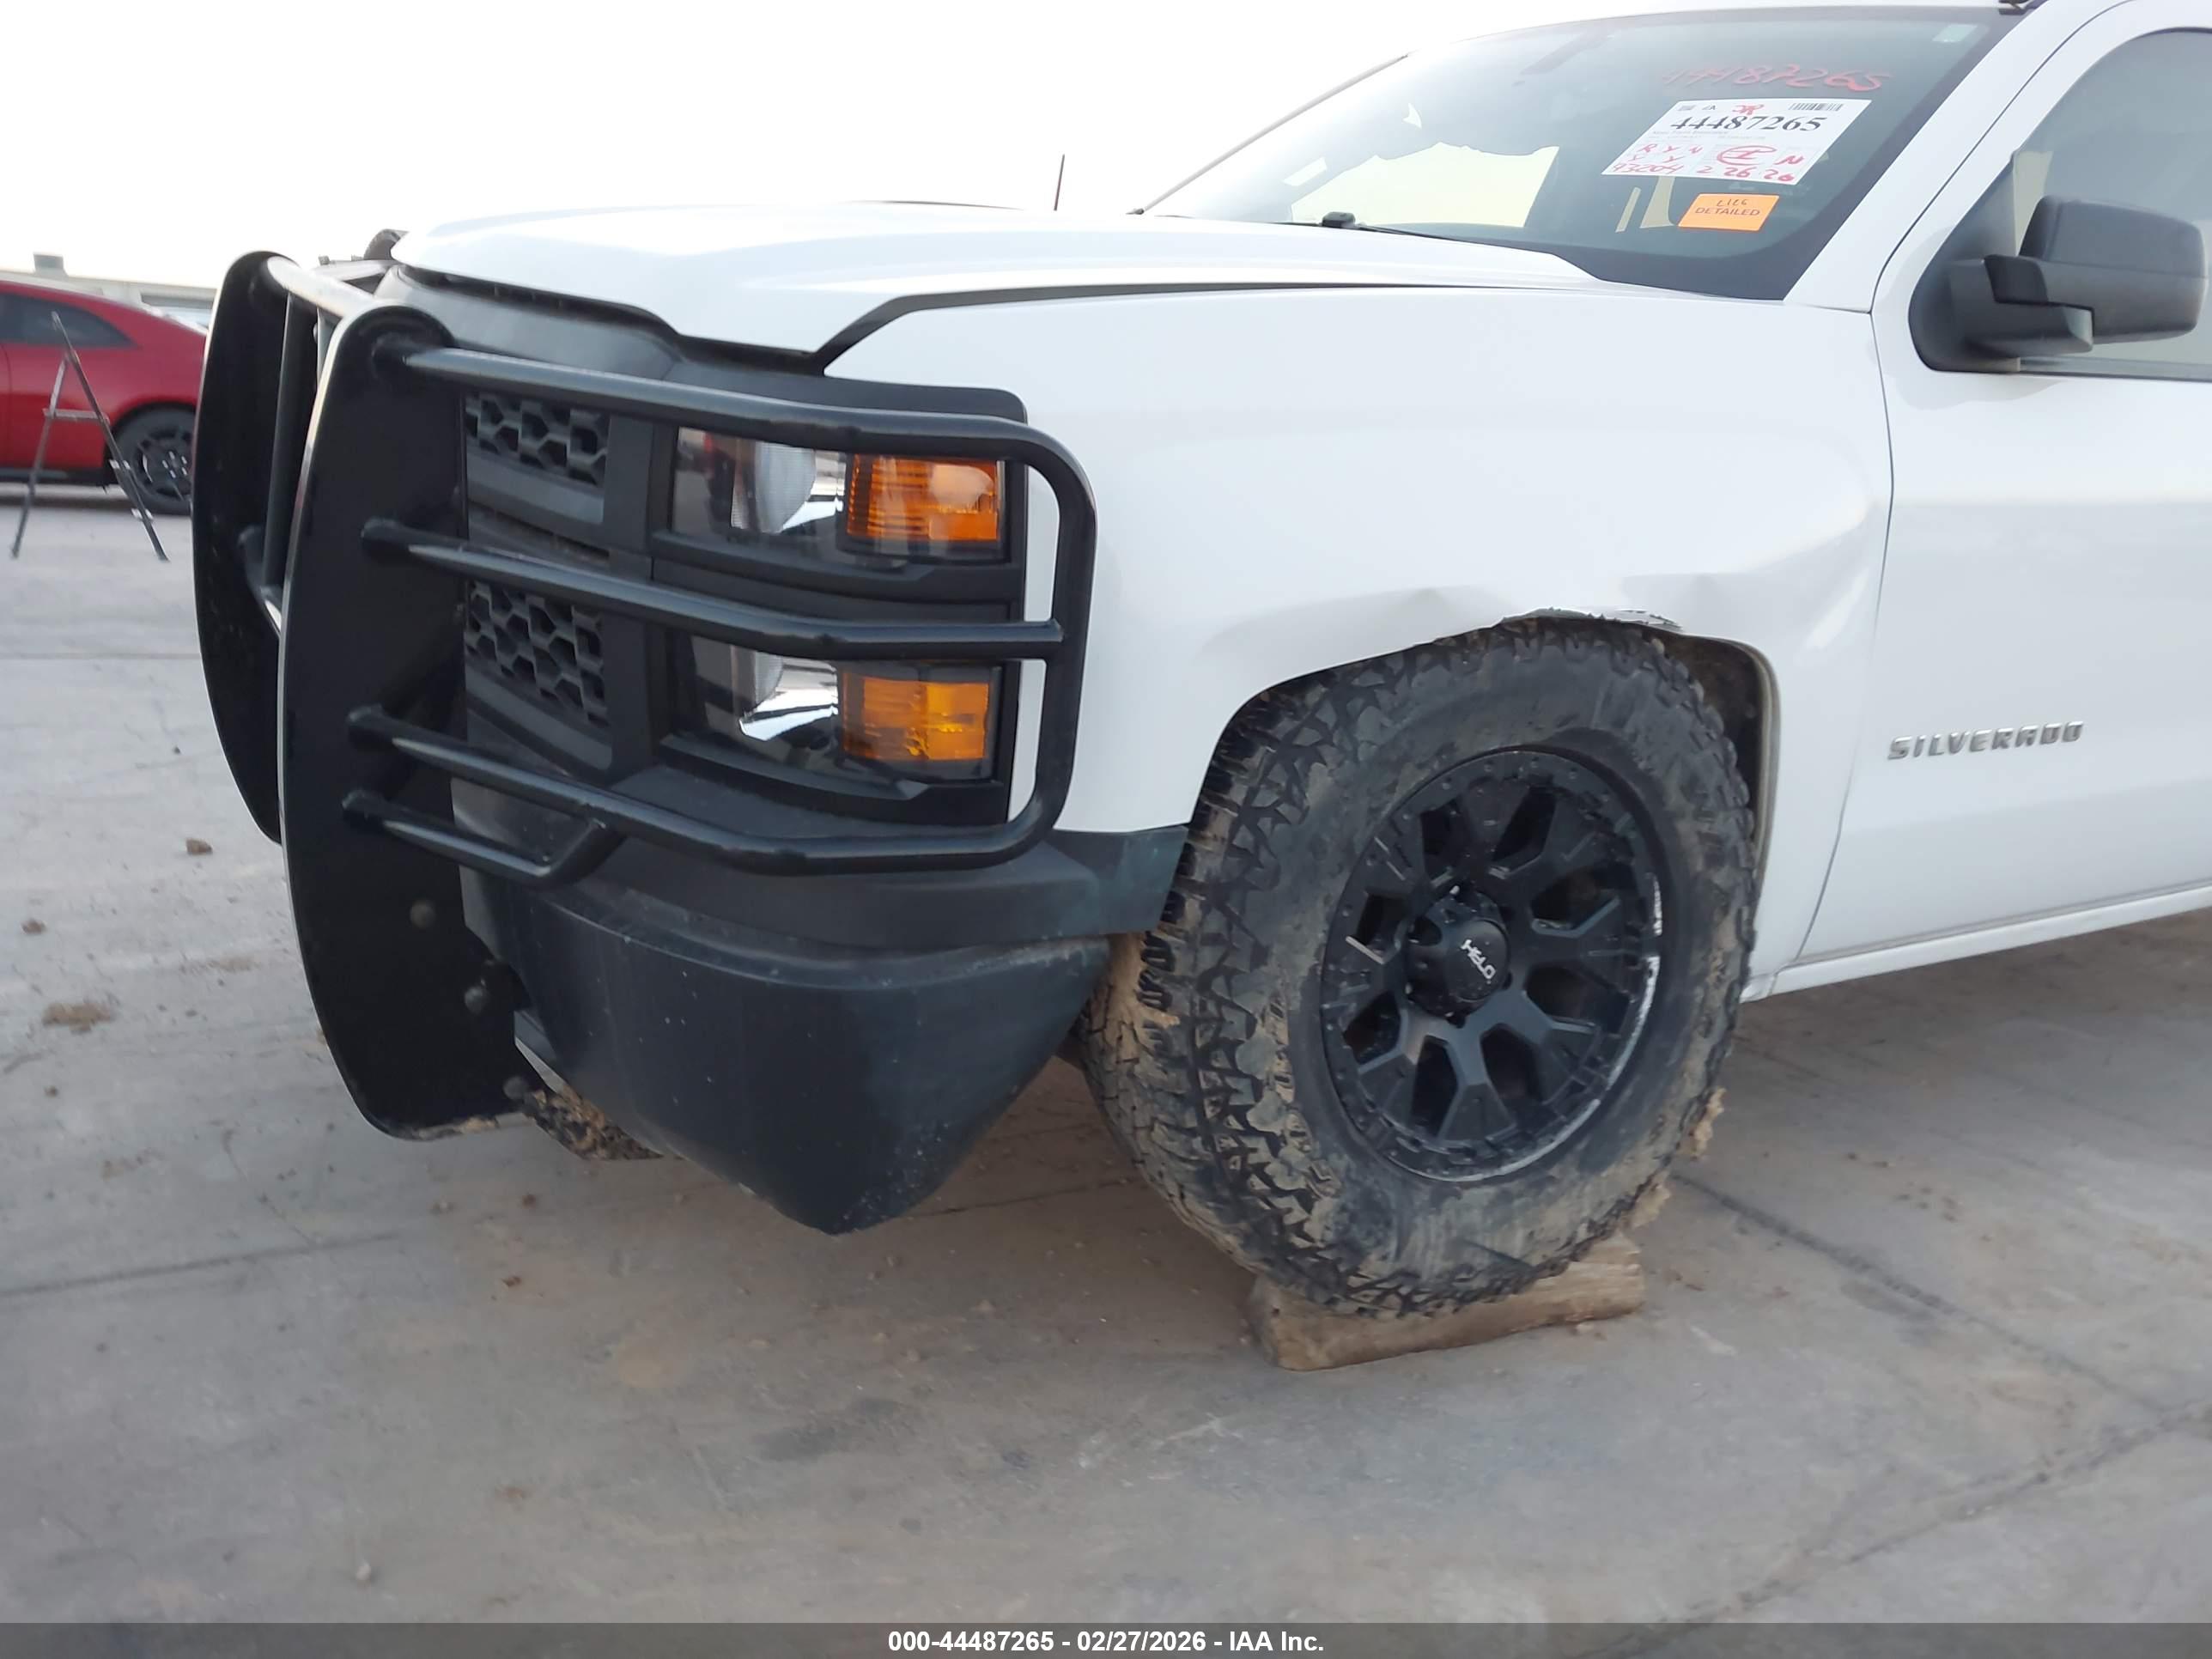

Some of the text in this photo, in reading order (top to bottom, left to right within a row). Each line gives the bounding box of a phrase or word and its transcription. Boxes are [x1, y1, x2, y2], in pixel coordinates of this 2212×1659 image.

[1670, 116, 1827, 131] 44487265
[1724, 167, 1757, 178] 26
[1695, 207, 1760, 216] DETAILED
[1887, 721, 2084, 760] SILVERADO
